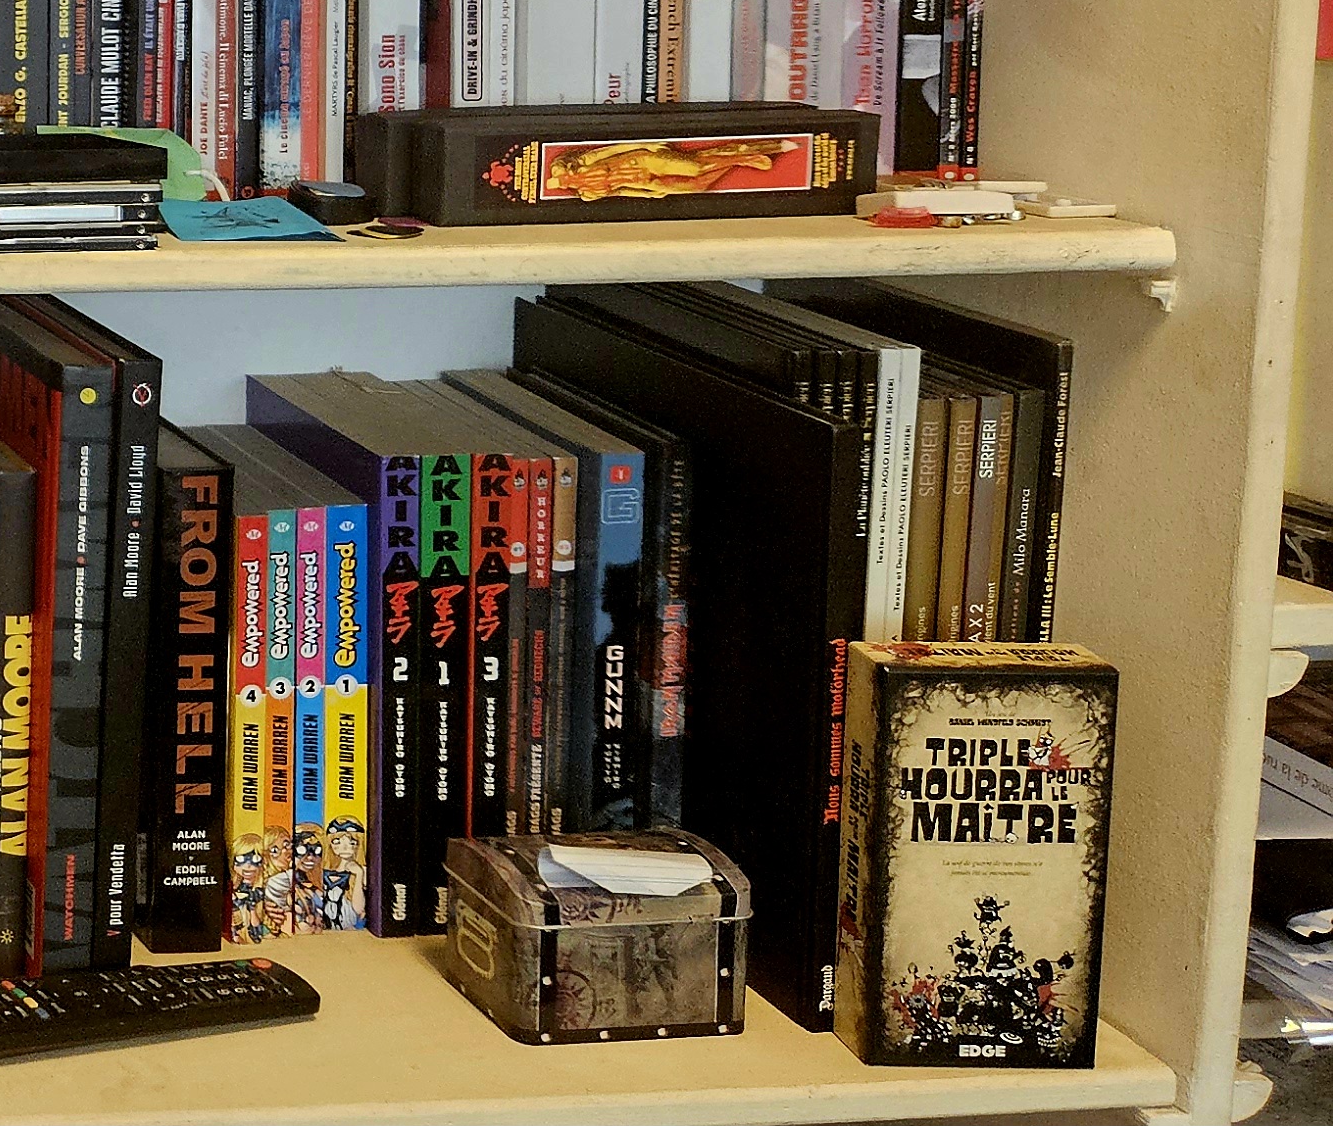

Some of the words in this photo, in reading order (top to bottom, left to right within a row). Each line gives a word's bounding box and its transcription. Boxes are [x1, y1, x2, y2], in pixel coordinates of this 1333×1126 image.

[102, 28, 120, 73] MULOT
[379, 34, 395, 69] Sion
[467, 50, 477, 95] DRIVE-IN
[101, 77, 119, 128] CLAUDE
[1057, 372, 1068, 406] Forest
[130, 445, 145, 472] Lloyd
[919, 421, 940, 496] SERPIERI
[979, 419, 996, 478] SERPIERI
[79, 446, 90, 513] GIBBONS
[127, 474, 143, 515] David
[78, 517, 88, 554] DAVE
[385, 456, 419, 574] AKIRA
[431, 455, 471, 577] AKIRA
[476, 453, 511, 575] AKIRA
[1016, 488, 1031, 541] Manara
[177, 476, 218, 635] FROM
[1014, 544, 1026, 575] Milo
[241, 561, 263, 668] empowered
[270, 552, 291, 659] empowered
[299, 552, 319, 658] empowered
[334, 542, 357, 667] empowered
[393, 657, 408, 681] 2
[438, 661, 449, 685] 1
[484, 657, 499, 680] 3
[604, 645, 624, 729] GUNNM
[174, 654, 216, 815] HELL
[242, 723, 259, 773] WARREN
[271, 715, 289, 765] WARREN
[339, 713, 355, 762] WARREN
[925, 738, 1032, 767] TRIPLE
[242, 777, 258, 811] ADAM
[339, 766, 355, 800] ADAM
[900, 768, 1043, 801] HOURRA
[911, 802, 1078, 843] MAÎTRE
[111, 844, 125, 890] Vendetta
[173, 841, 210, 851] MOORE
[64, 854, 77, 941] WATCHMEN
[163, 875, 217, 886] CAMPBELL
[109, 893, 122, 925] pour
[959, 1045, 1006, 1057] EDGE
